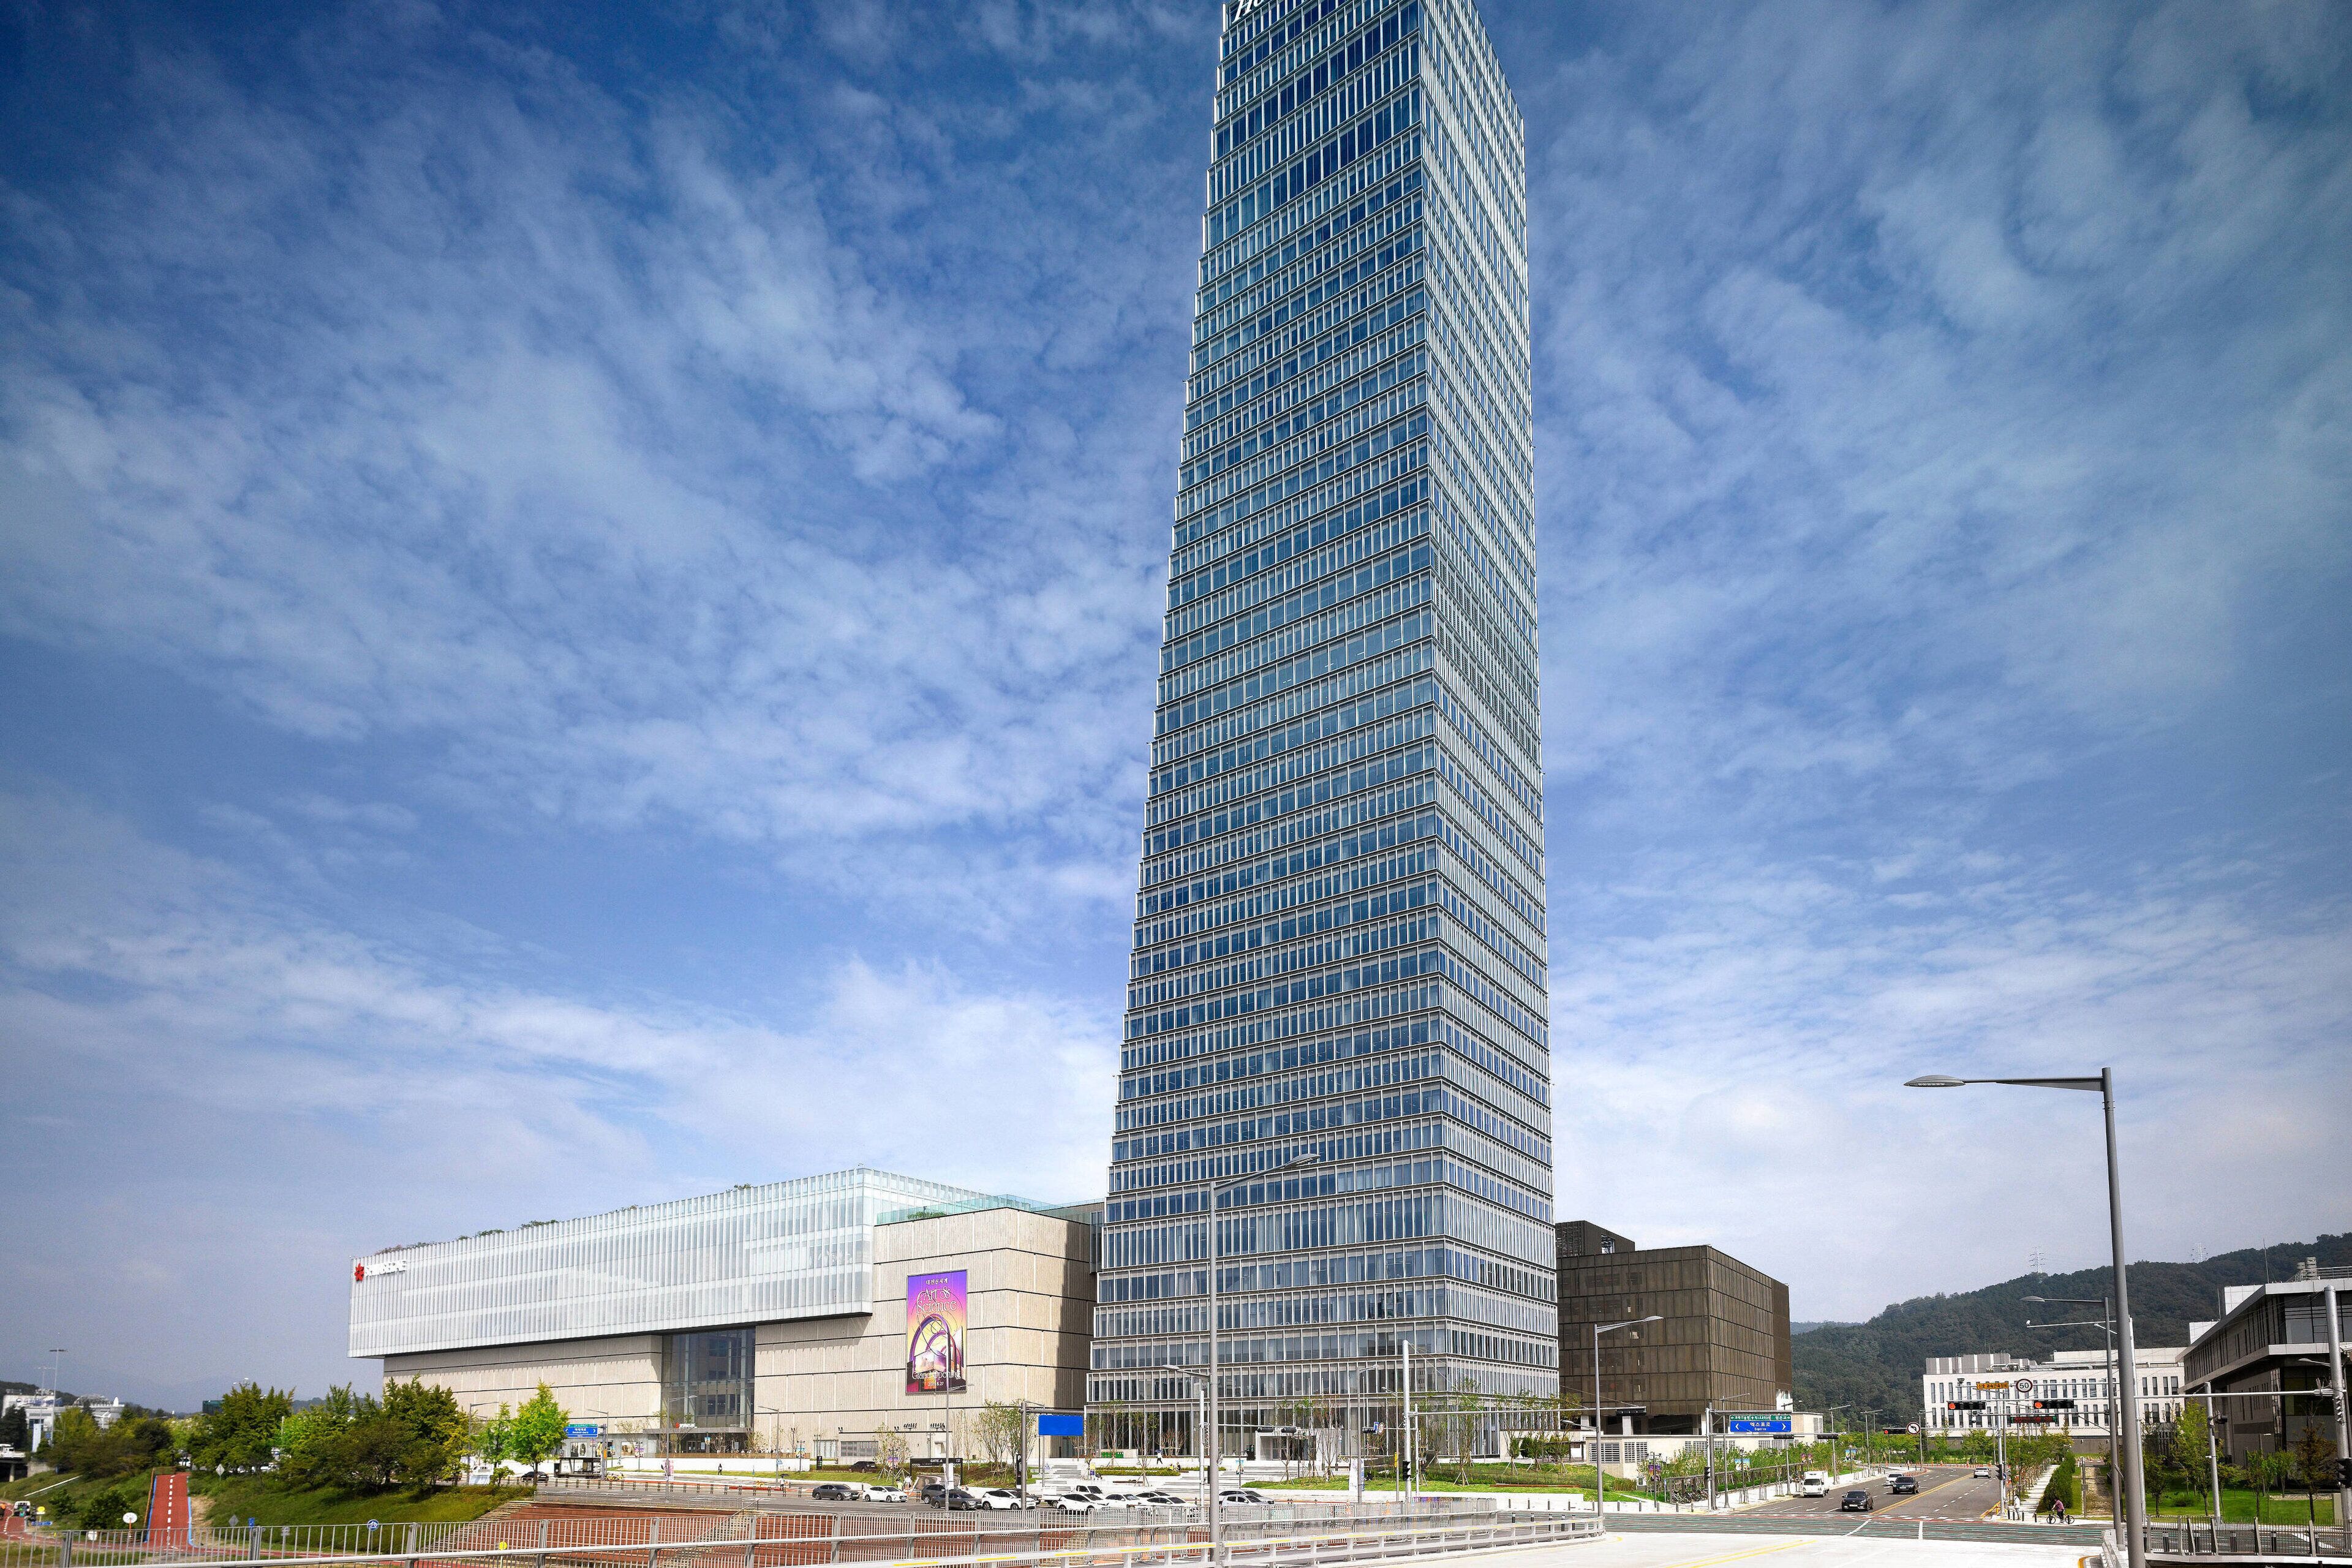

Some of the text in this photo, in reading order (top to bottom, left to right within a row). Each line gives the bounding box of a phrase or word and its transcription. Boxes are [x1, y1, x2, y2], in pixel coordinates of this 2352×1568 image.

[919, 1286, 951, 1301] Art &
[917, 1300, 957, 1314] Science
[912, 1370, 960, 1380] Grand Opening
